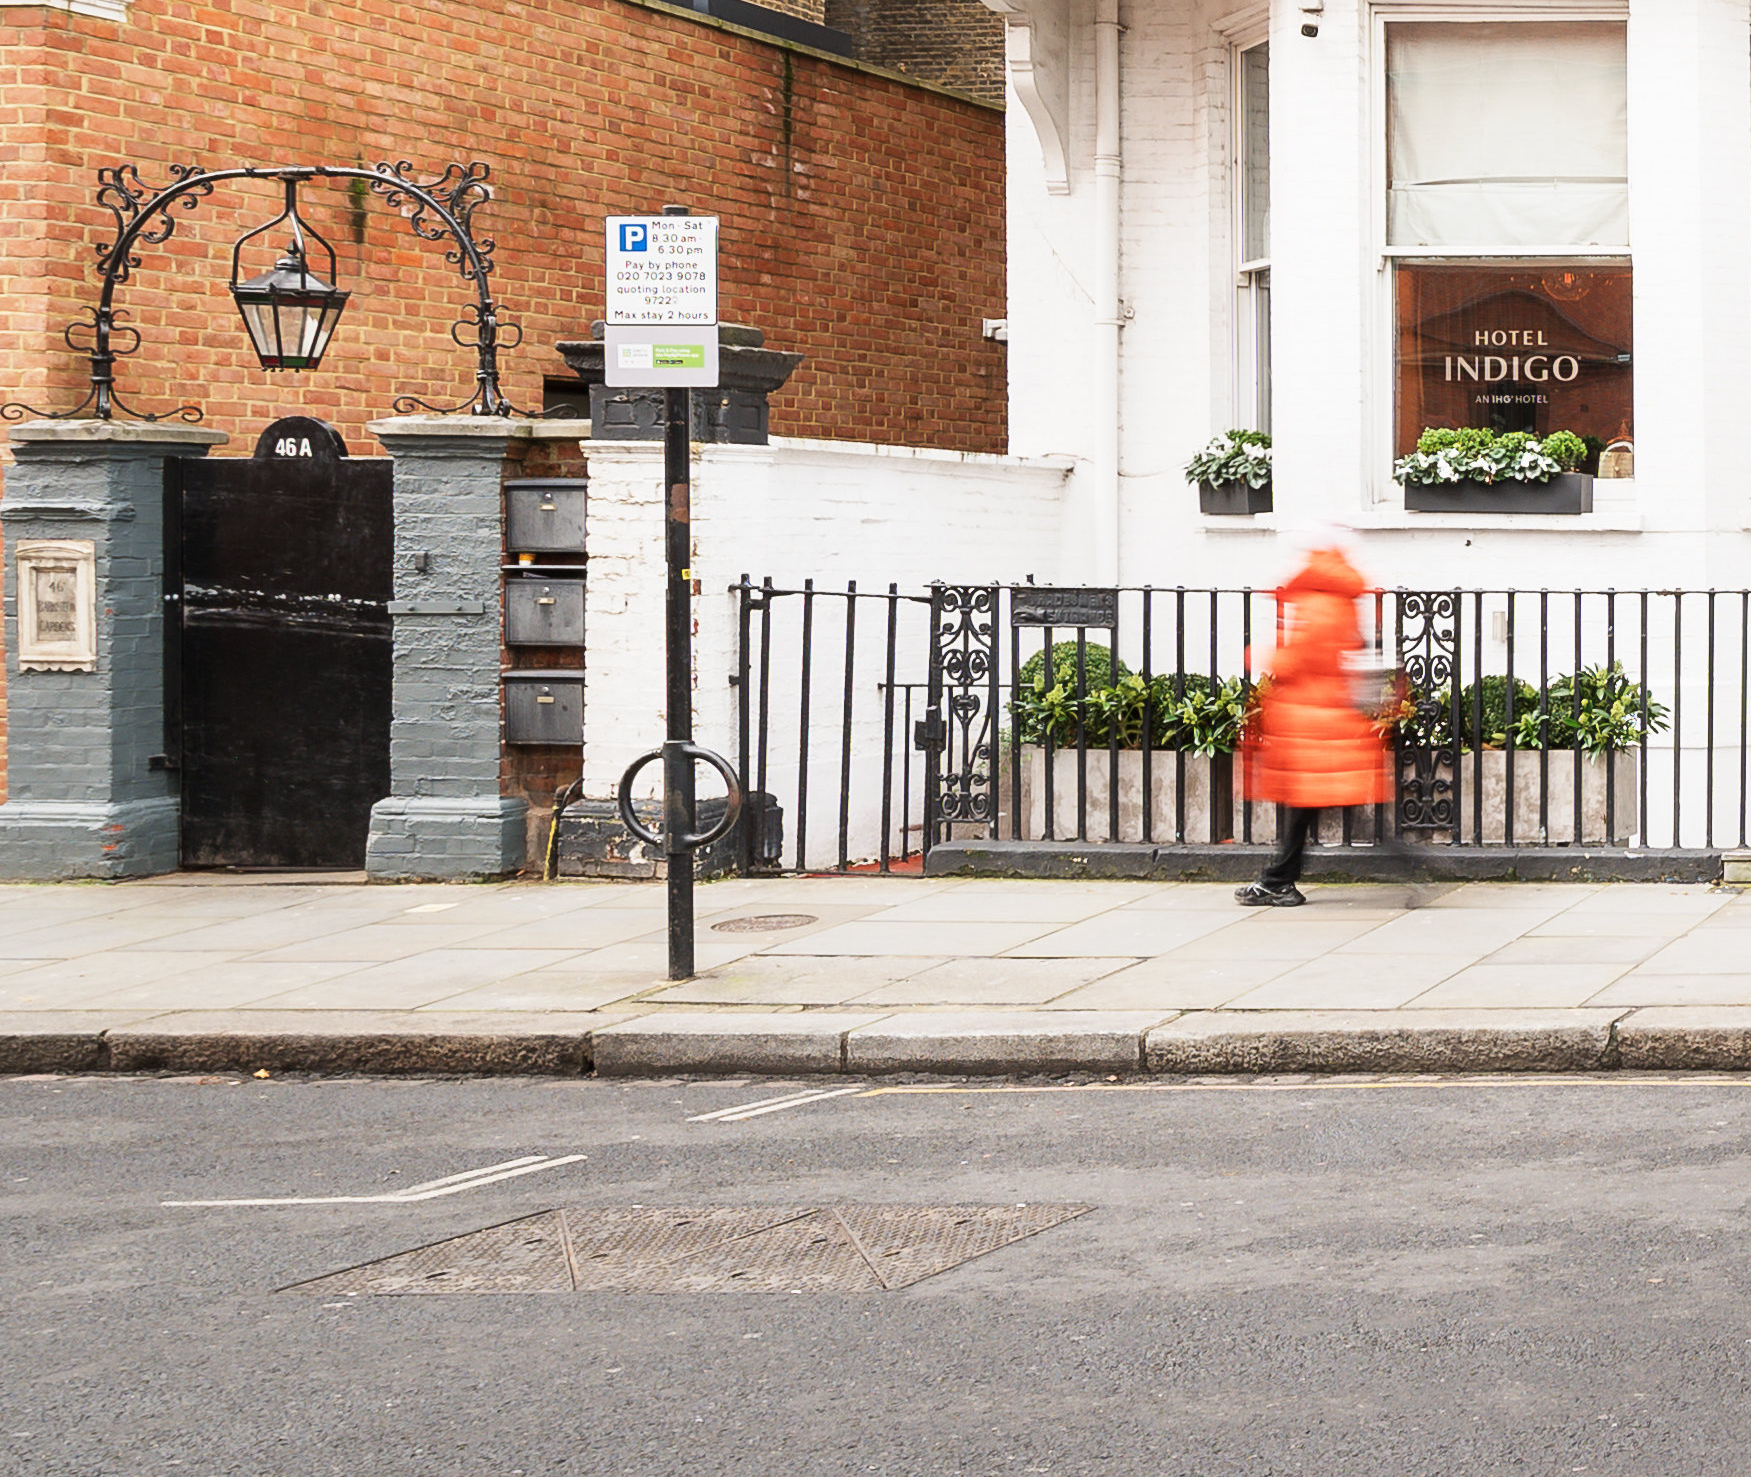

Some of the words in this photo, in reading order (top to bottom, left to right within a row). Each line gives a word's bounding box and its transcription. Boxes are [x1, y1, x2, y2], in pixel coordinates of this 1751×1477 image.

[652, 221, 675, 230] Mon
[684, 221, 703, 230] Sat
[624, 226, 645, 251] P
[625, 261, 644, 270] Pay
[648, 261, 660, 270] by
[665, 261, 698, 270] phone
[617, 272, 640, 280] 020
[644, 272, 673, 280] 7023
[677, 272, 706, 280] 9078
[617, 286, 658, 294] quoting
[662, 285, 706, 294] location
[614, 310, 637, 319] Max
[641, 311, 663, 320] stay
[668, 311, 674, 319] 2
[678, 311, 709, 319] hours
[1475, 330, 1549, 346] HOTEL
[1445, 355, 1579, 382] INDIGO
[1475, 395, 1490, 404] AN
[1515, 395, 1549, 404] HOTEL
